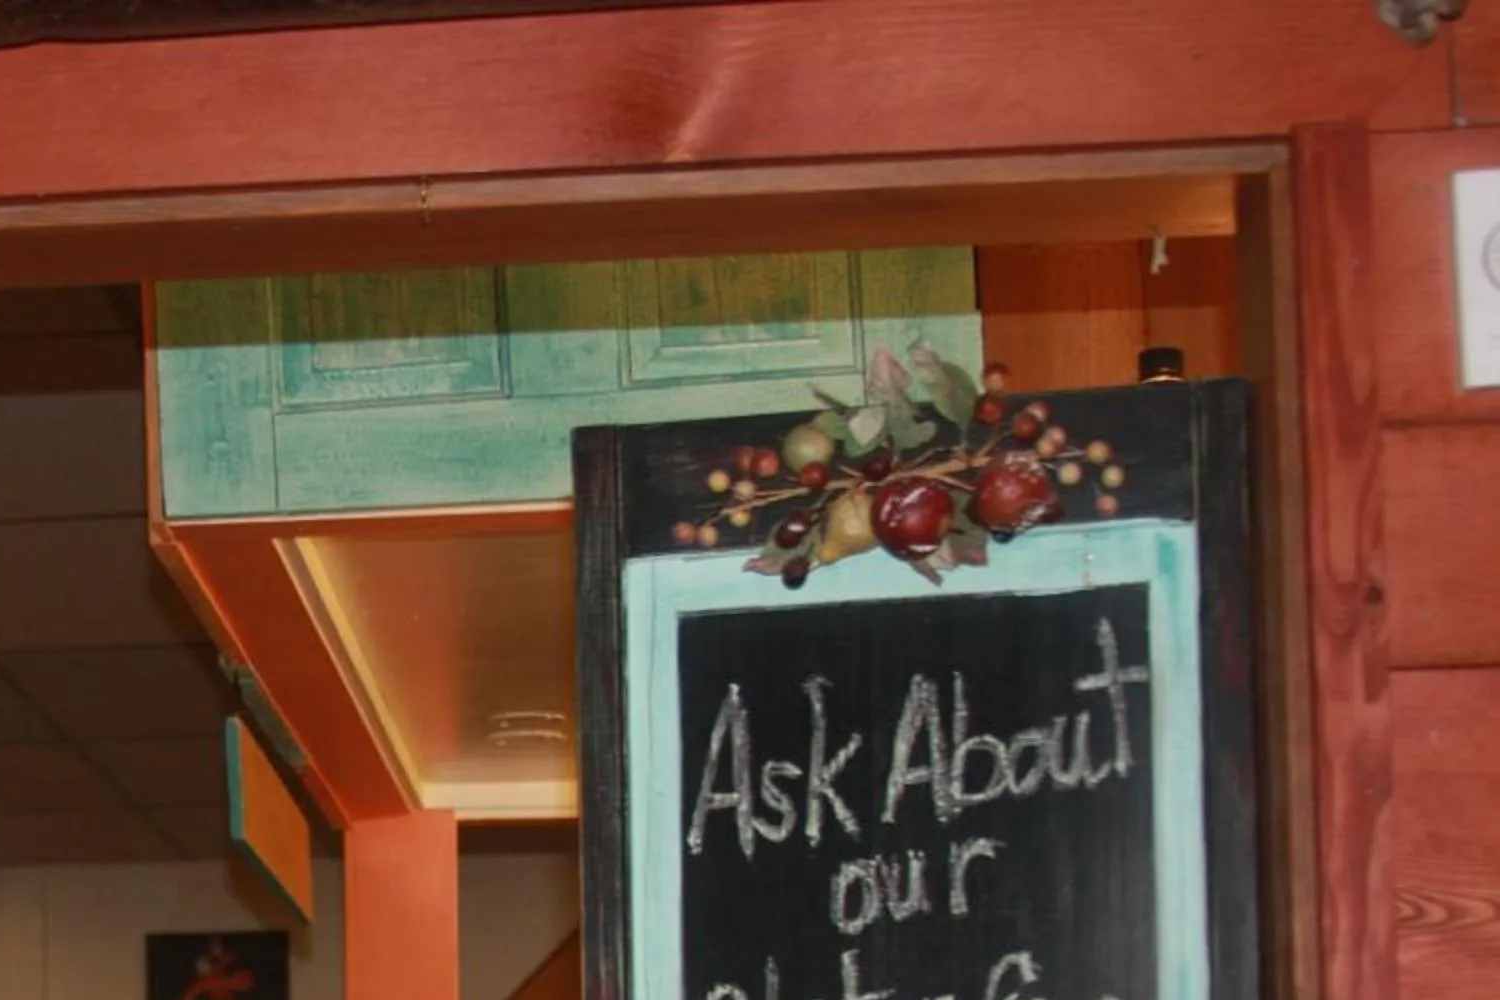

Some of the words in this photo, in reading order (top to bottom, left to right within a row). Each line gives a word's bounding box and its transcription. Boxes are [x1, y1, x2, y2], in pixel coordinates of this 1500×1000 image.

[688, 676, 863, 860] Ask
[882, 617, 1149, 822] About
[830, 838, 1004, 936] our
